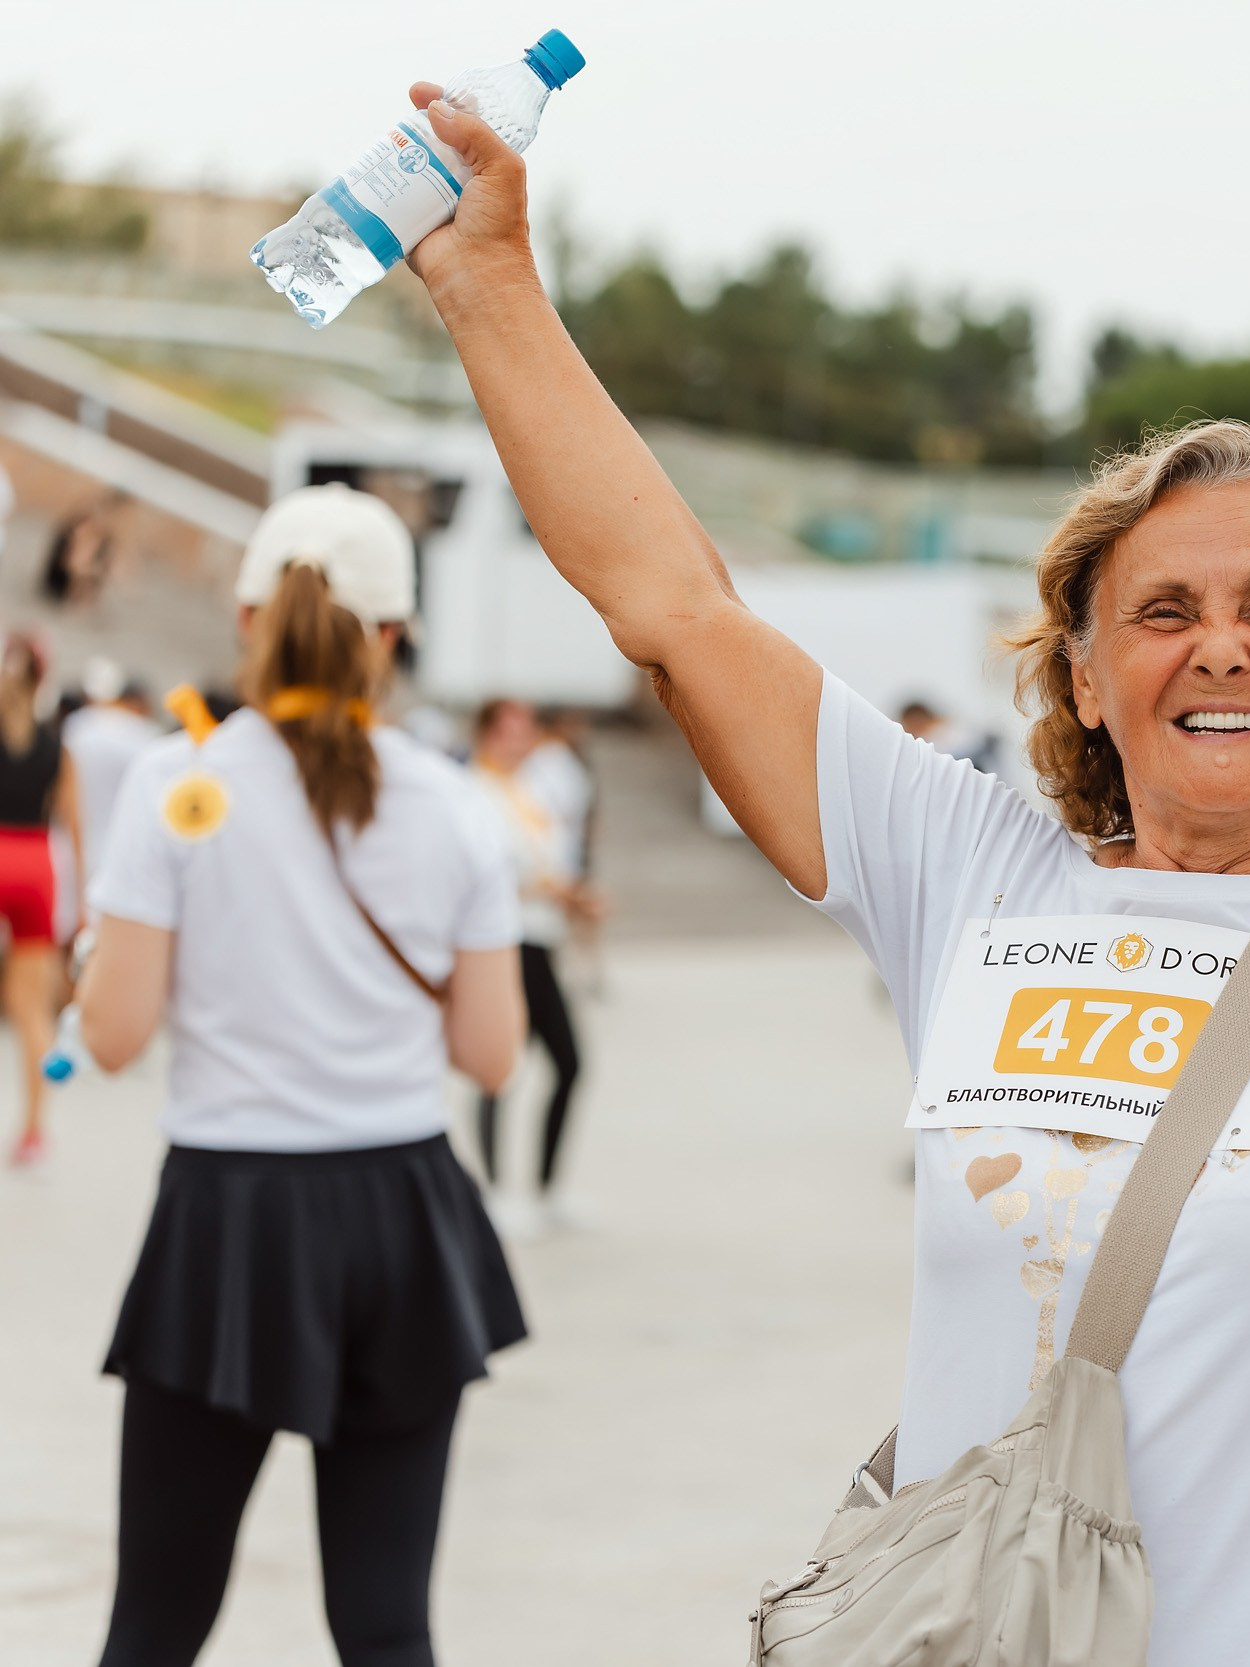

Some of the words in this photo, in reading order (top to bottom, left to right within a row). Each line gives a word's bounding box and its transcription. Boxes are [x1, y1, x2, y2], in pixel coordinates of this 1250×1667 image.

[983, 942, 1098, 966] LEONE
[1160, 947, 1238, 978] D'OR
[1016, 998, 1184, 1074] 478
[946, 1087, 1166, 1118] БЛАГОТВОРИТЕЛЬНЫЙ
